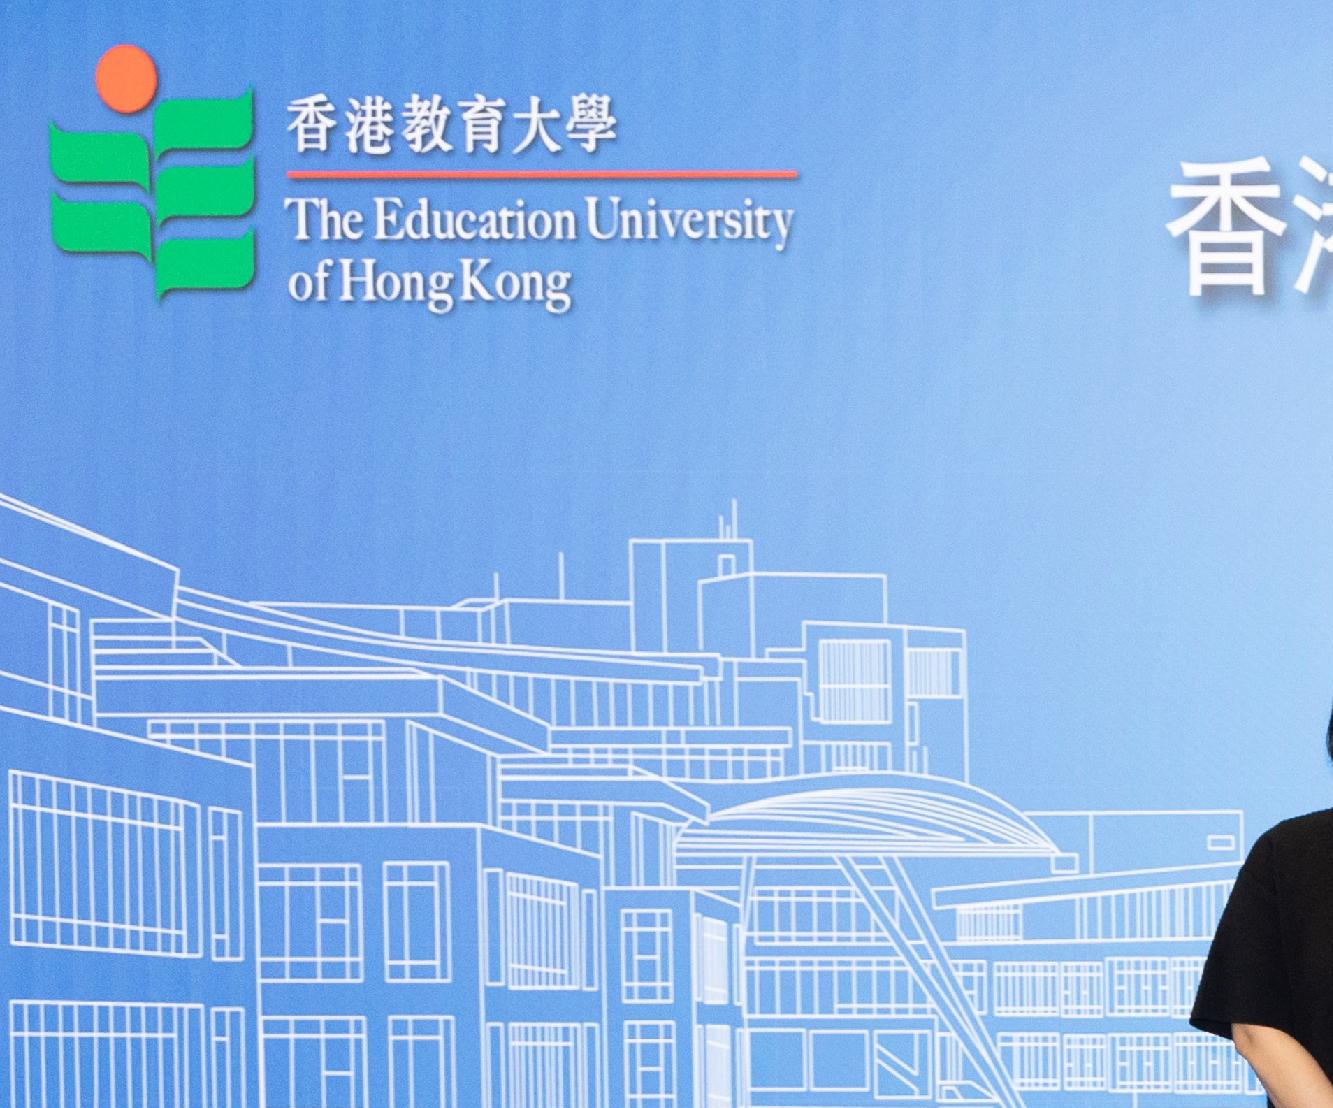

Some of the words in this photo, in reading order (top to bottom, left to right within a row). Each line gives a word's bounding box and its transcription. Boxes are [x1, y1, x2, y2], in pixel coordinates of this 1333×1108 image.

[287, 92, 617, 156] 香港教育大學
[284, 198, 363, 241] The
[375, 197, 576, 240] Education
[586, 196, 794, 252] University
[288, 258, 334, 302] of
[340, 258, 454, 314] Hong
[461, 258, 572, 314] Kong
